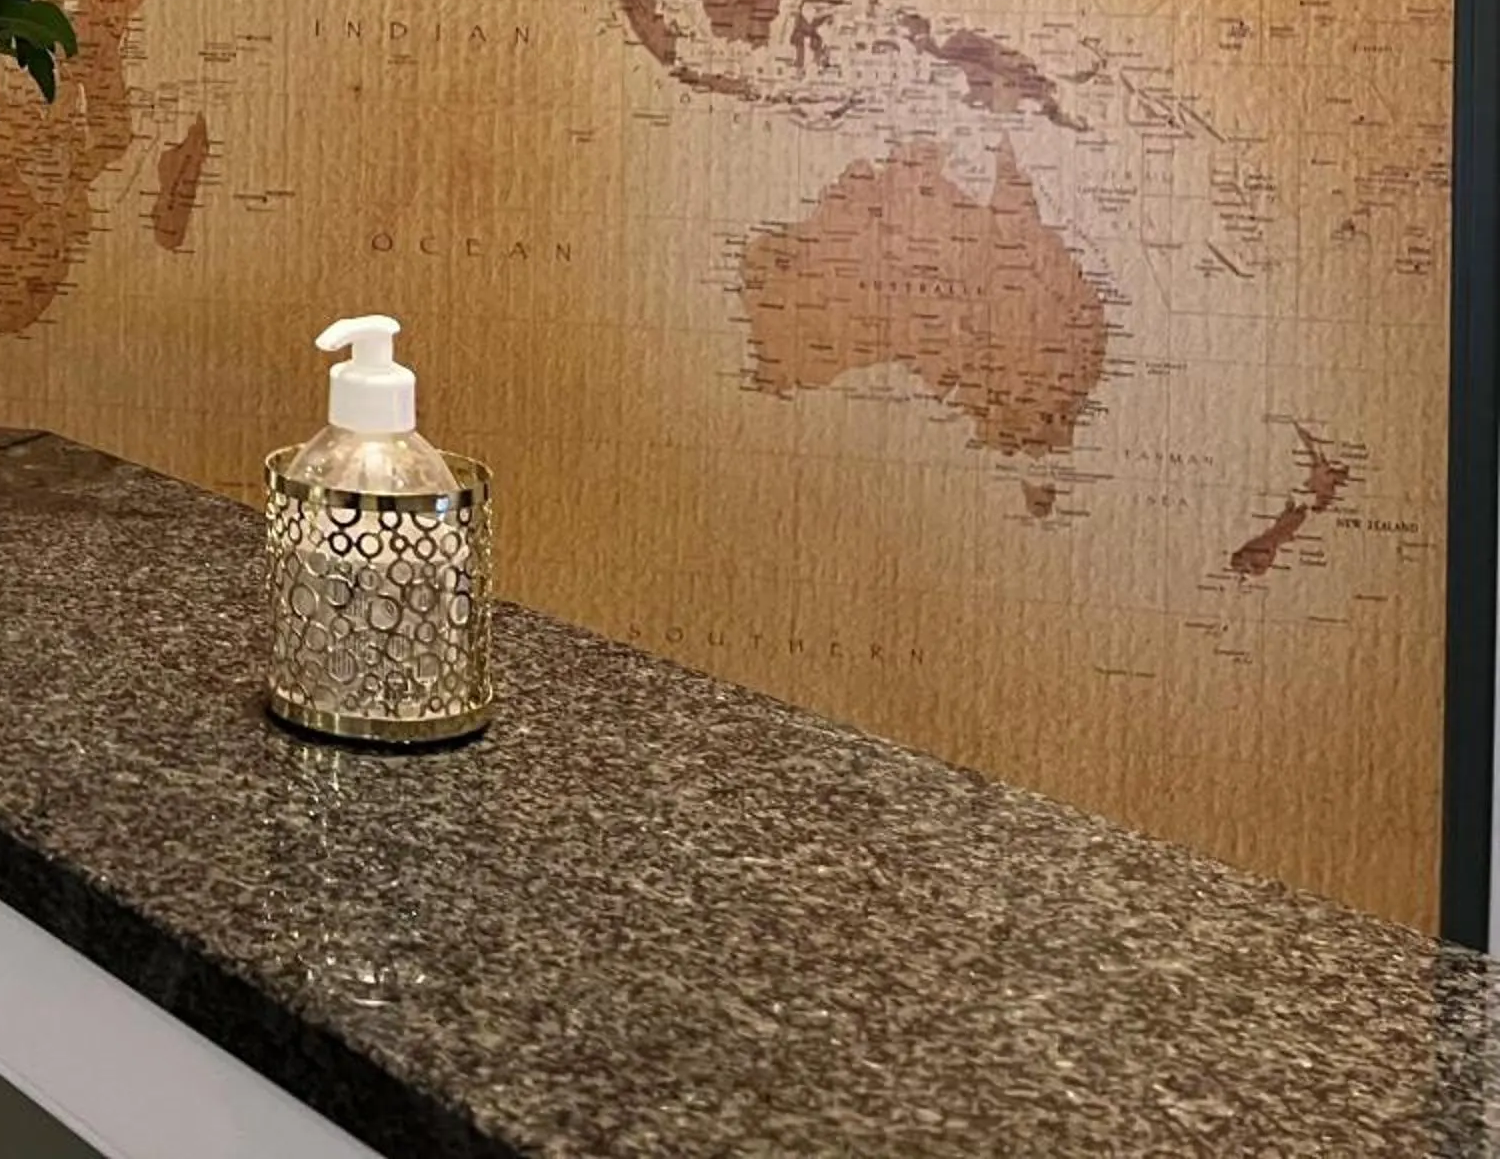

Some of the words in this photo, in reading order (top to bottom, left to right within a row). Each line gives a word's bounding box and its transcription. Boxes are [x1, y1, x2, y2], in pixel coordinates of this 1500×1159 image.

[314, 18, 531, 46] INDIAN
[371, 232, 572, 263] OCEAN
[630, 623, 923, 666] SOUTHERN
